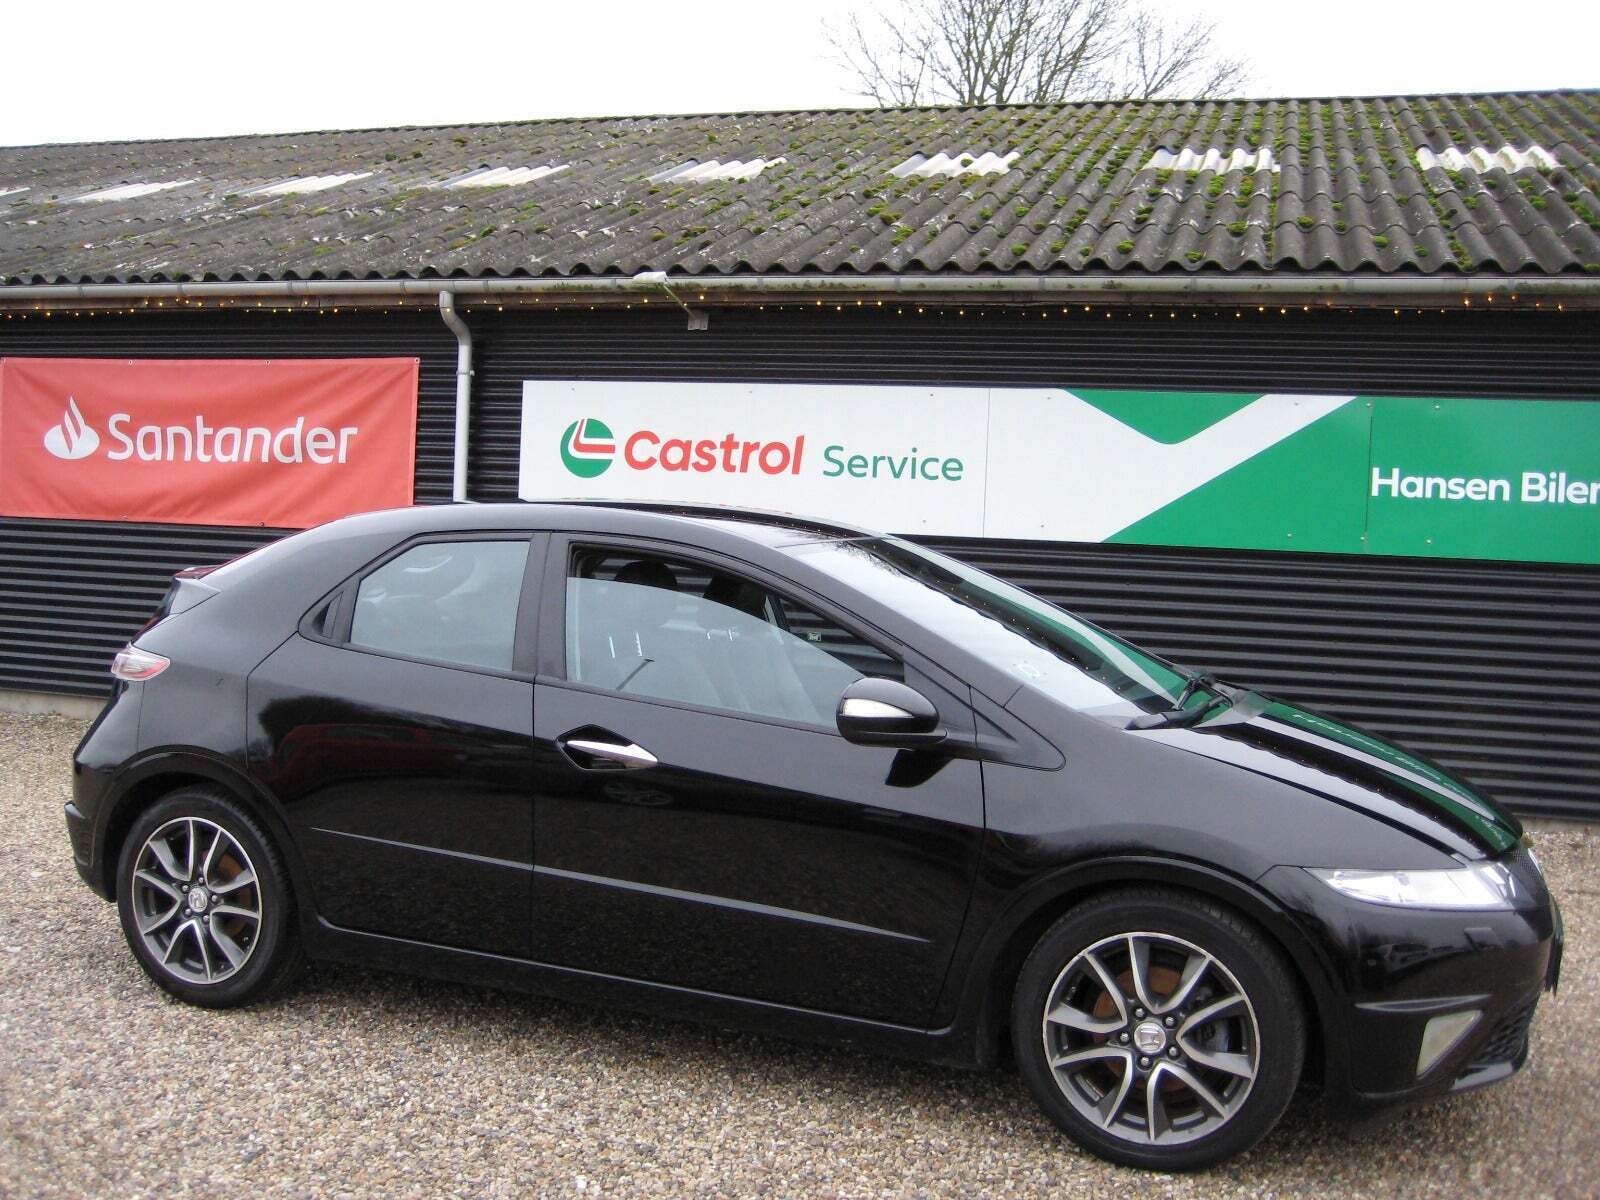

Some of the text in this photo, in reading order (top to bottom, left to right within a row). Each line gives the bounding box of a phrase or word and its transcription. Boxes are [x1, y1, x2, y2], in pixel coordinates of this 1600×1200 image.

[107, 412, 358, 464] Santander
[624, 429, 964, 481] Castrol Service
[1371, 467, 1511, 502] Hansen
